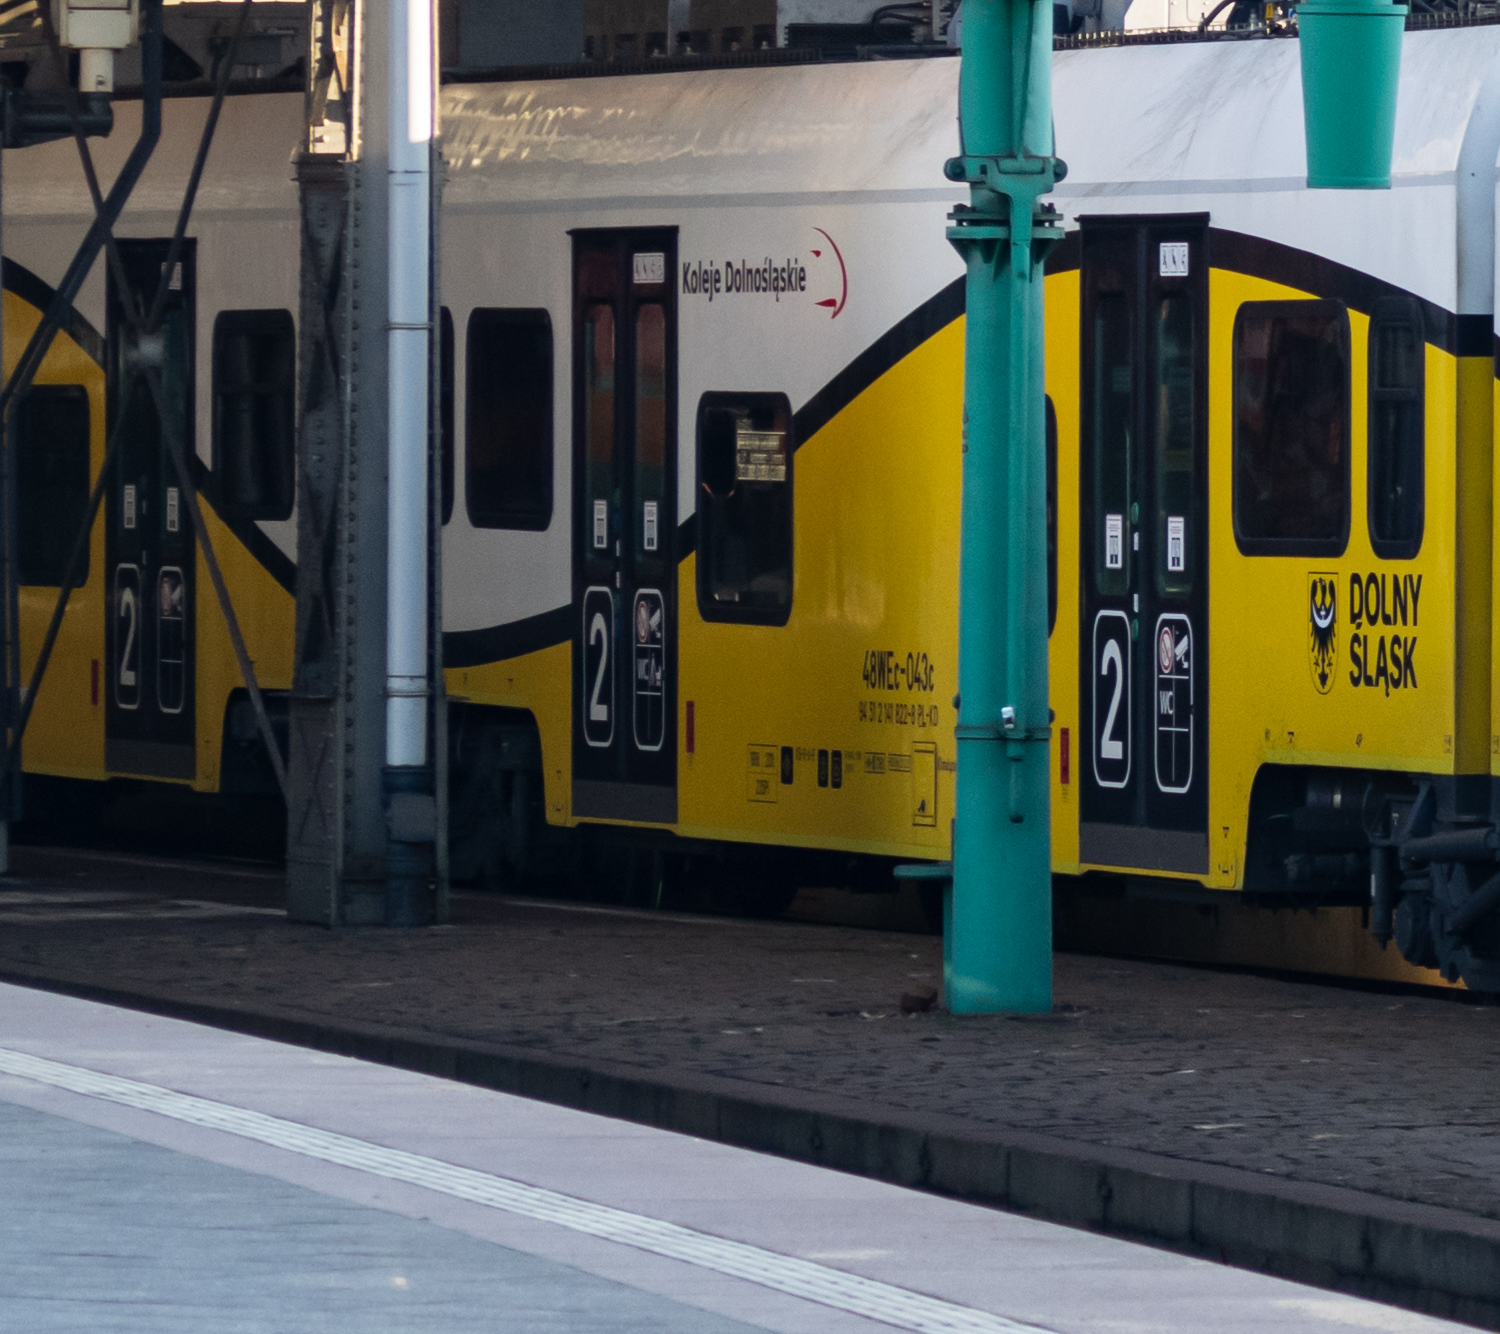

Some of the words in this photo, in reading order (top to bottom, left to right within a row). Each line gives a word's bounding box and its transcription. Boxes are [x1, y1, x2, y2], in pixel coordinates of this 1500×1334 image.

[682, 260, 721, 302] Koleje
[724, 256, 806, 302] Dolnośląskie
[1349, 572, 1423, 627] DOLNY
[119, 586, 137, 686] 2
[589, 612, 608, 721] 2
[1349, 622, 1418, 698] ŚLĄSK
[862, 649, 935, 692] 48WEc-043c
[1100, 638, 1124, 760] 2
[1159, 690, 1174, 715] WC
